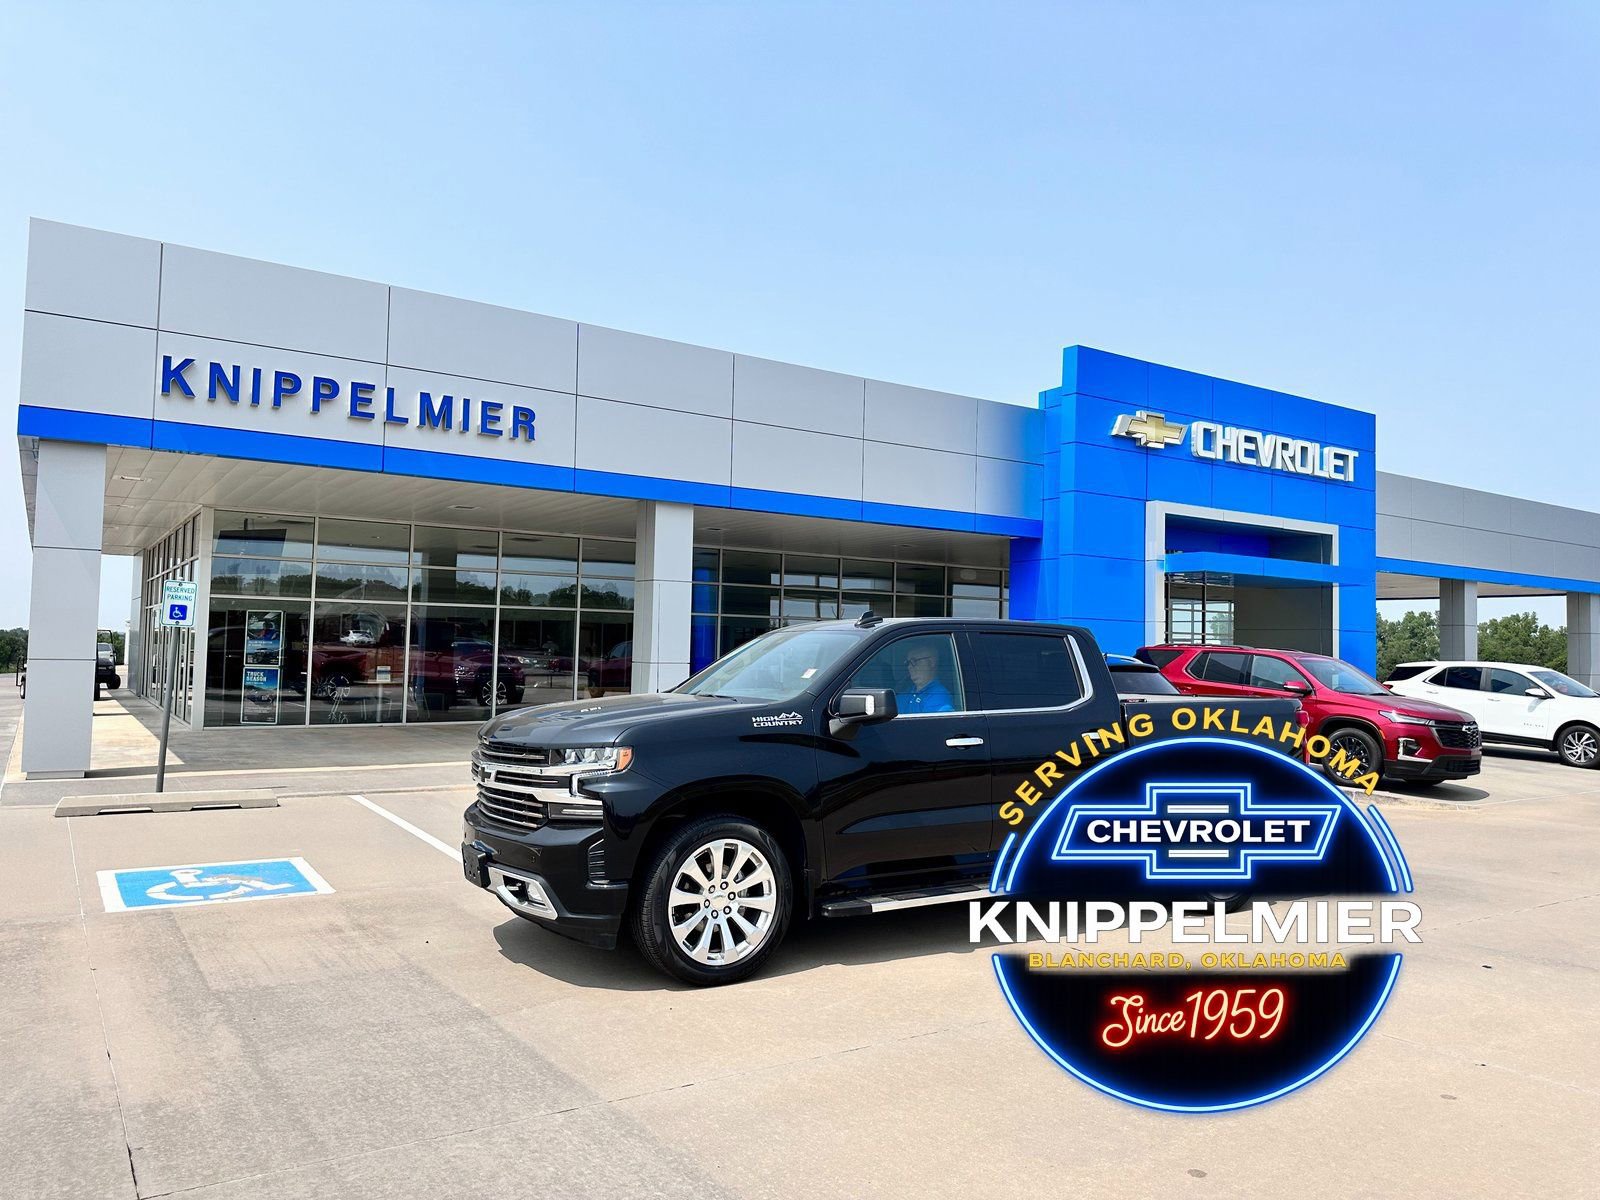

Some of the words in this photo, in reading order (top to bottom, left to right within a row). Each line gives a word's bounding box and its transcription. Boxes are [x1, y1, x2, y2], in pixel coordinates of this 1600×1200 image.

[161, 354, 537, 442] KNIPPELMIER
[1191, 421, 1359, 482] CHEVROLET
[166, 586, 195, 594] RESERVED
[167, 593, 193, 601] PARKING
